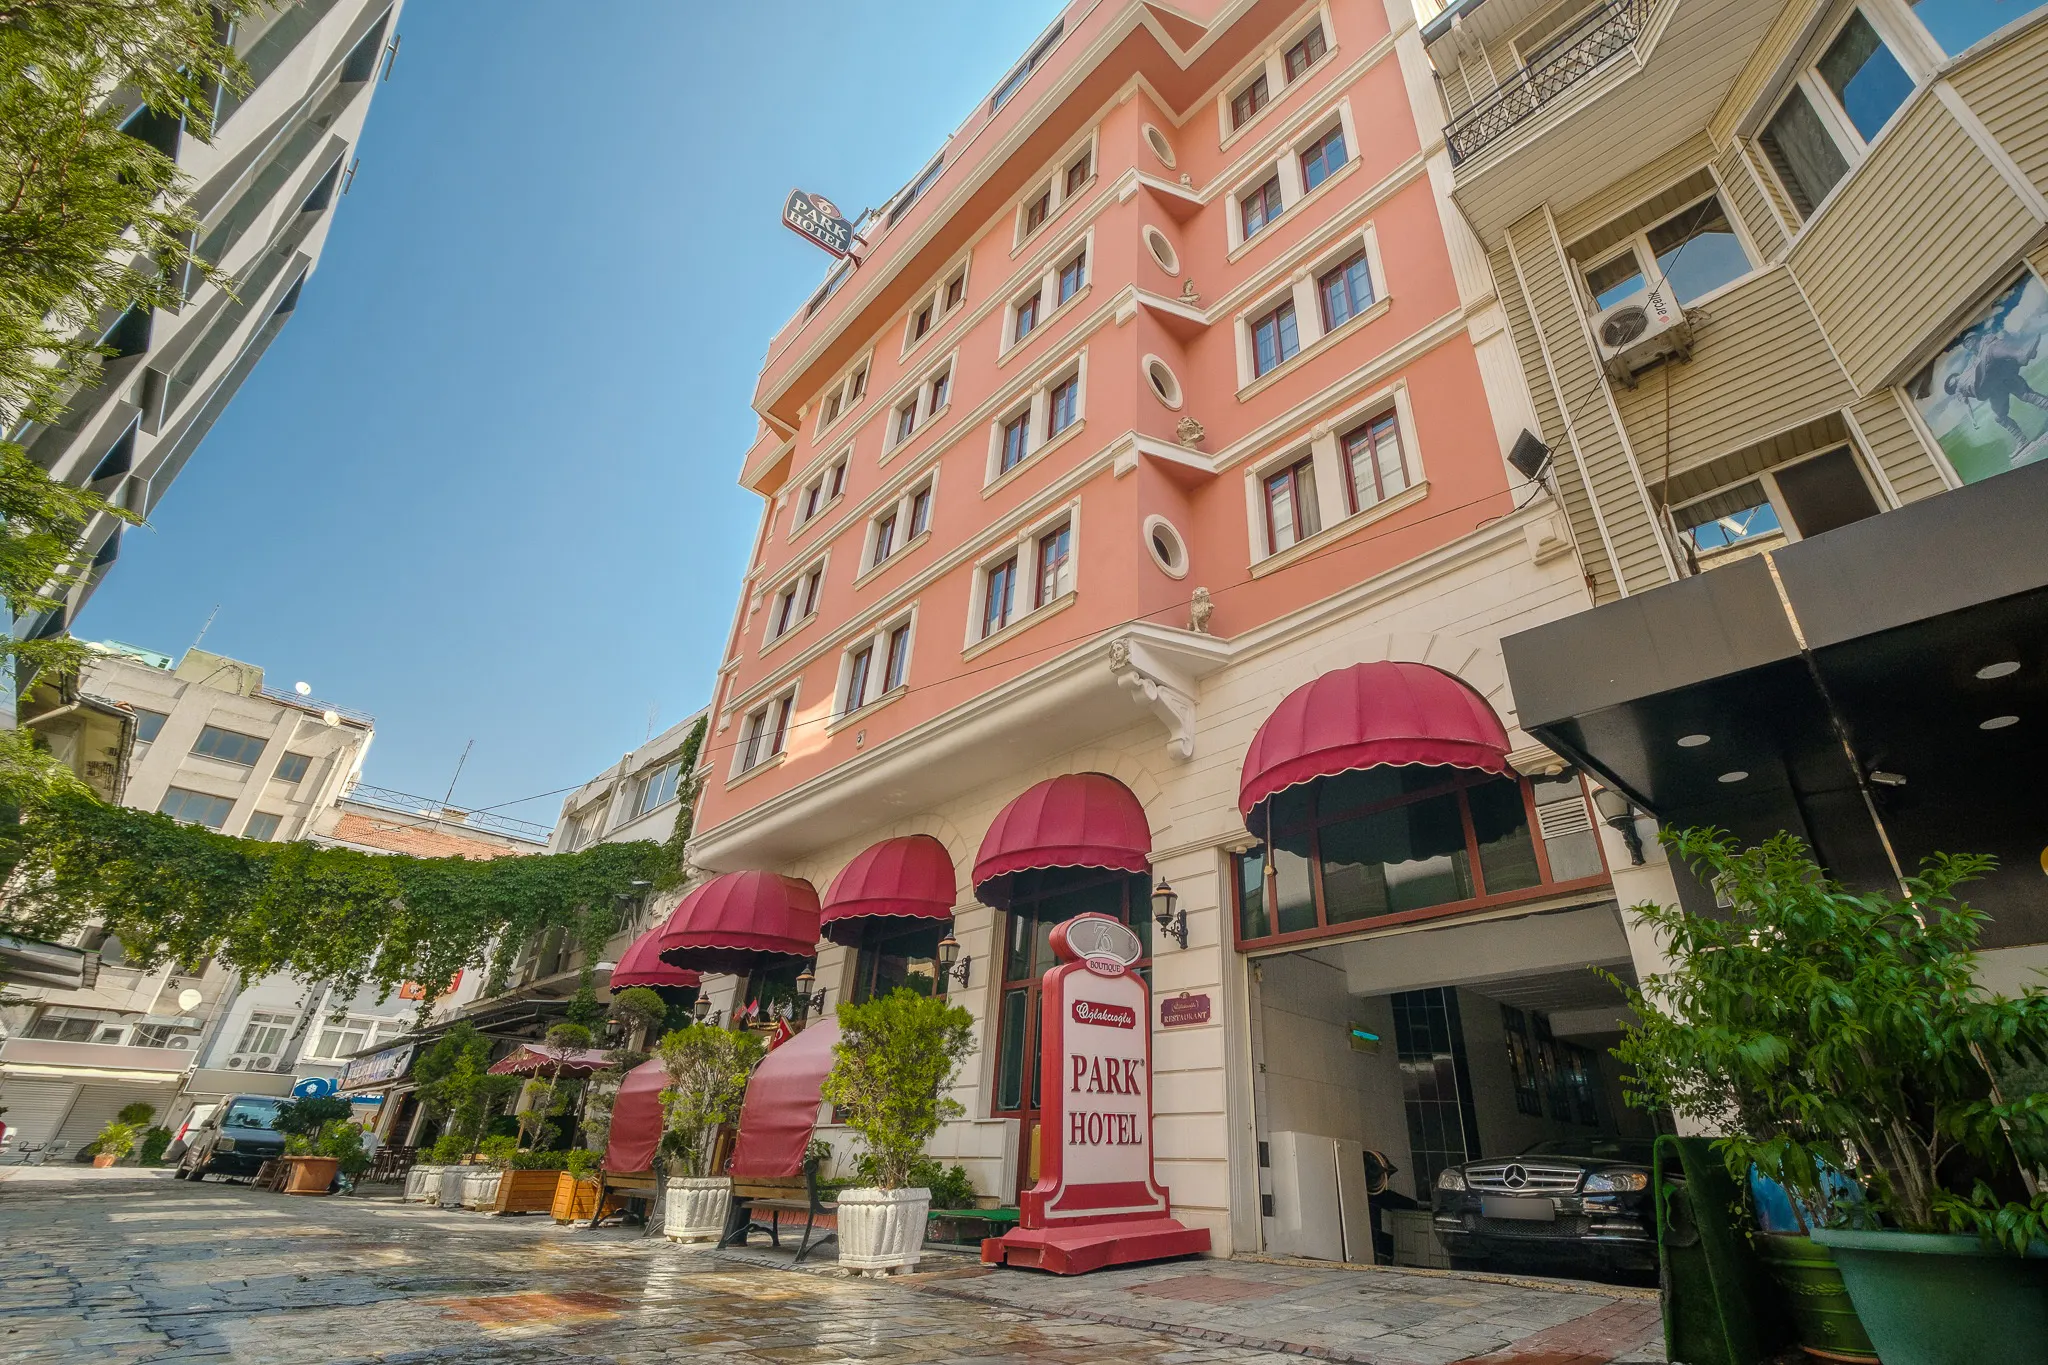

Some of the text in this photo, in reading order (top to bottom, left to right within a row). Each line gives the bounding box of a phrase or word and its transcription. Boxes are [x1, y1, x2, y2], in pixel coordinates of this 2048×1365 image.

[788, 210, 844, 252] HOTEL
[793, 198, 848, 241] PARK
[1090, 960, 1121, 973] BOUTIQUE
[1164, 1011, 1207, 1023] RESTAURANT
[1069, 1112, 1142, 1146] HOTEL
